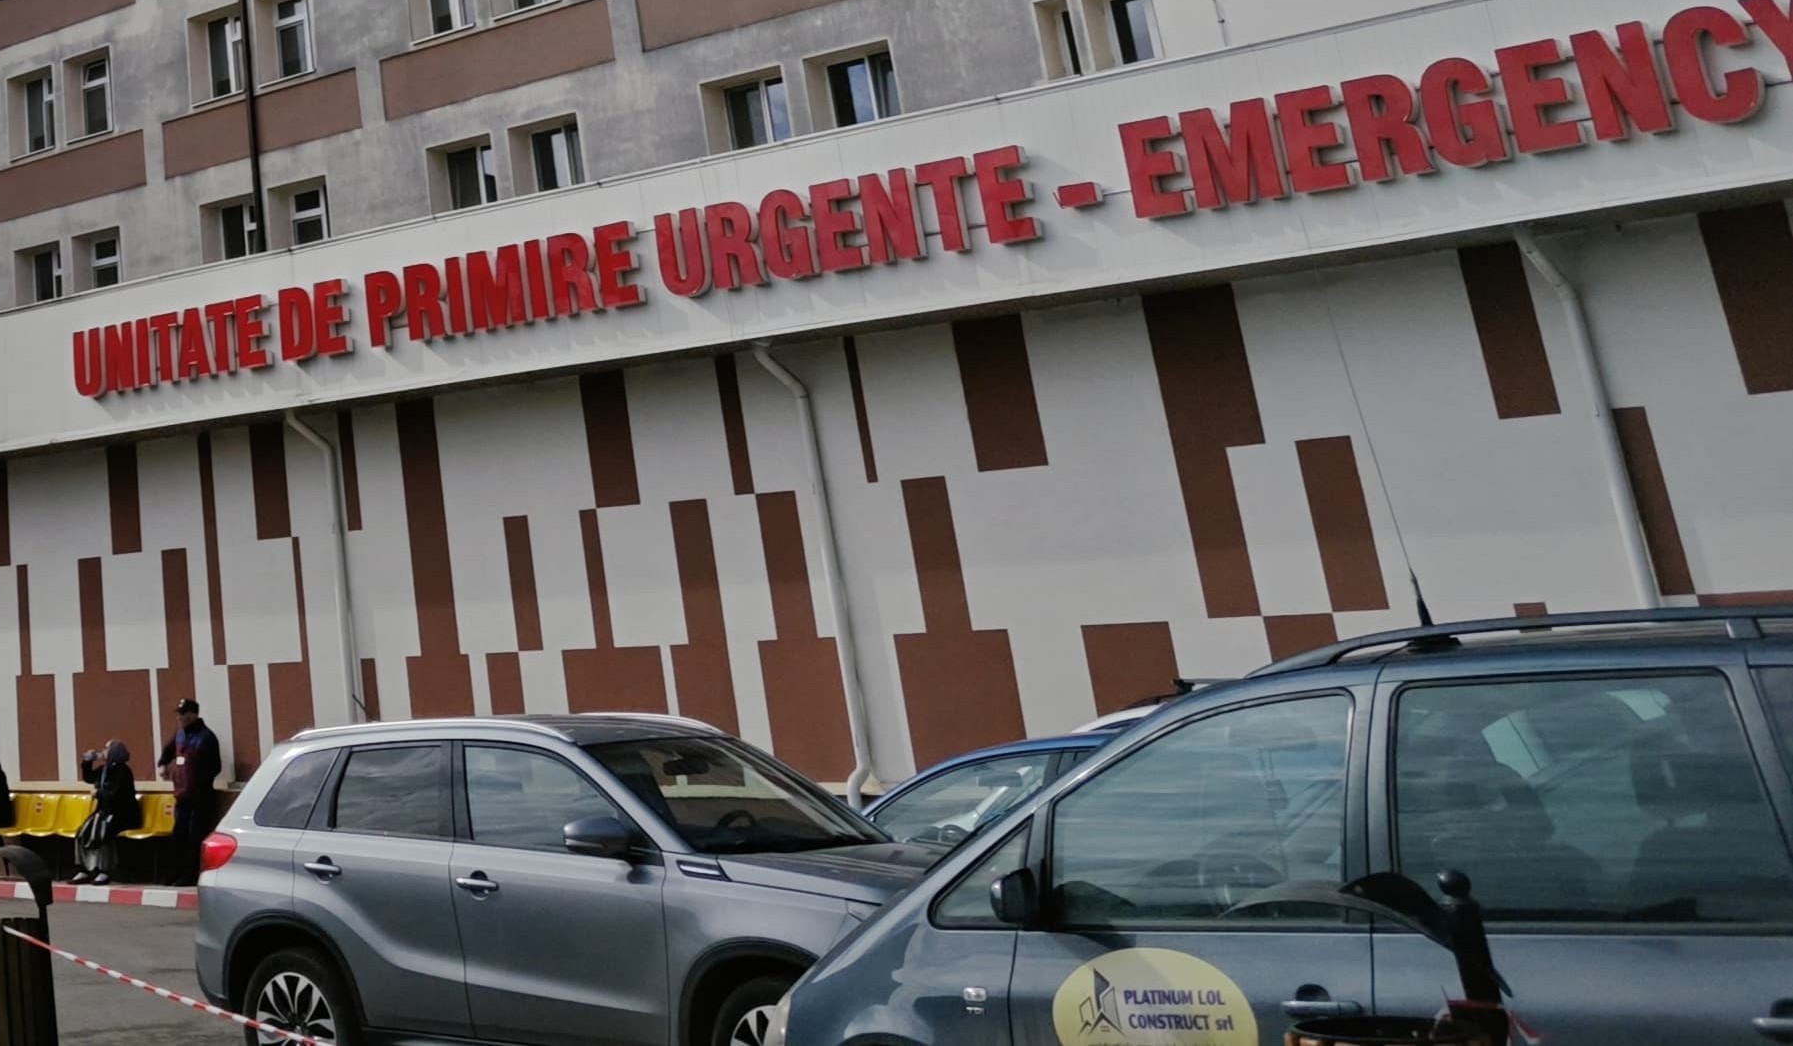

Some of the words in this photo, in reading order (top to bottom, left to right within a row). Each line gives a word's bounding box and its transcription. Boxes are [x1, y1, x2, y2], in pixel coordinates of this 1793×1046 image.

[72, 294, 270, 397] UNITATE
[278, 278, 352, 362] DE
[364, 221, 645, 348] PRIMIRE
[654, 145, 1041, 298] URGENTE
[1124, 989, 1194, 1005] PLATINUM
[1198, 989, 1226, 1005] LOL
[1129, 1014, 1210, 1030] CONSTRUCT
[1215, 1015, 1235, 1031] srl
